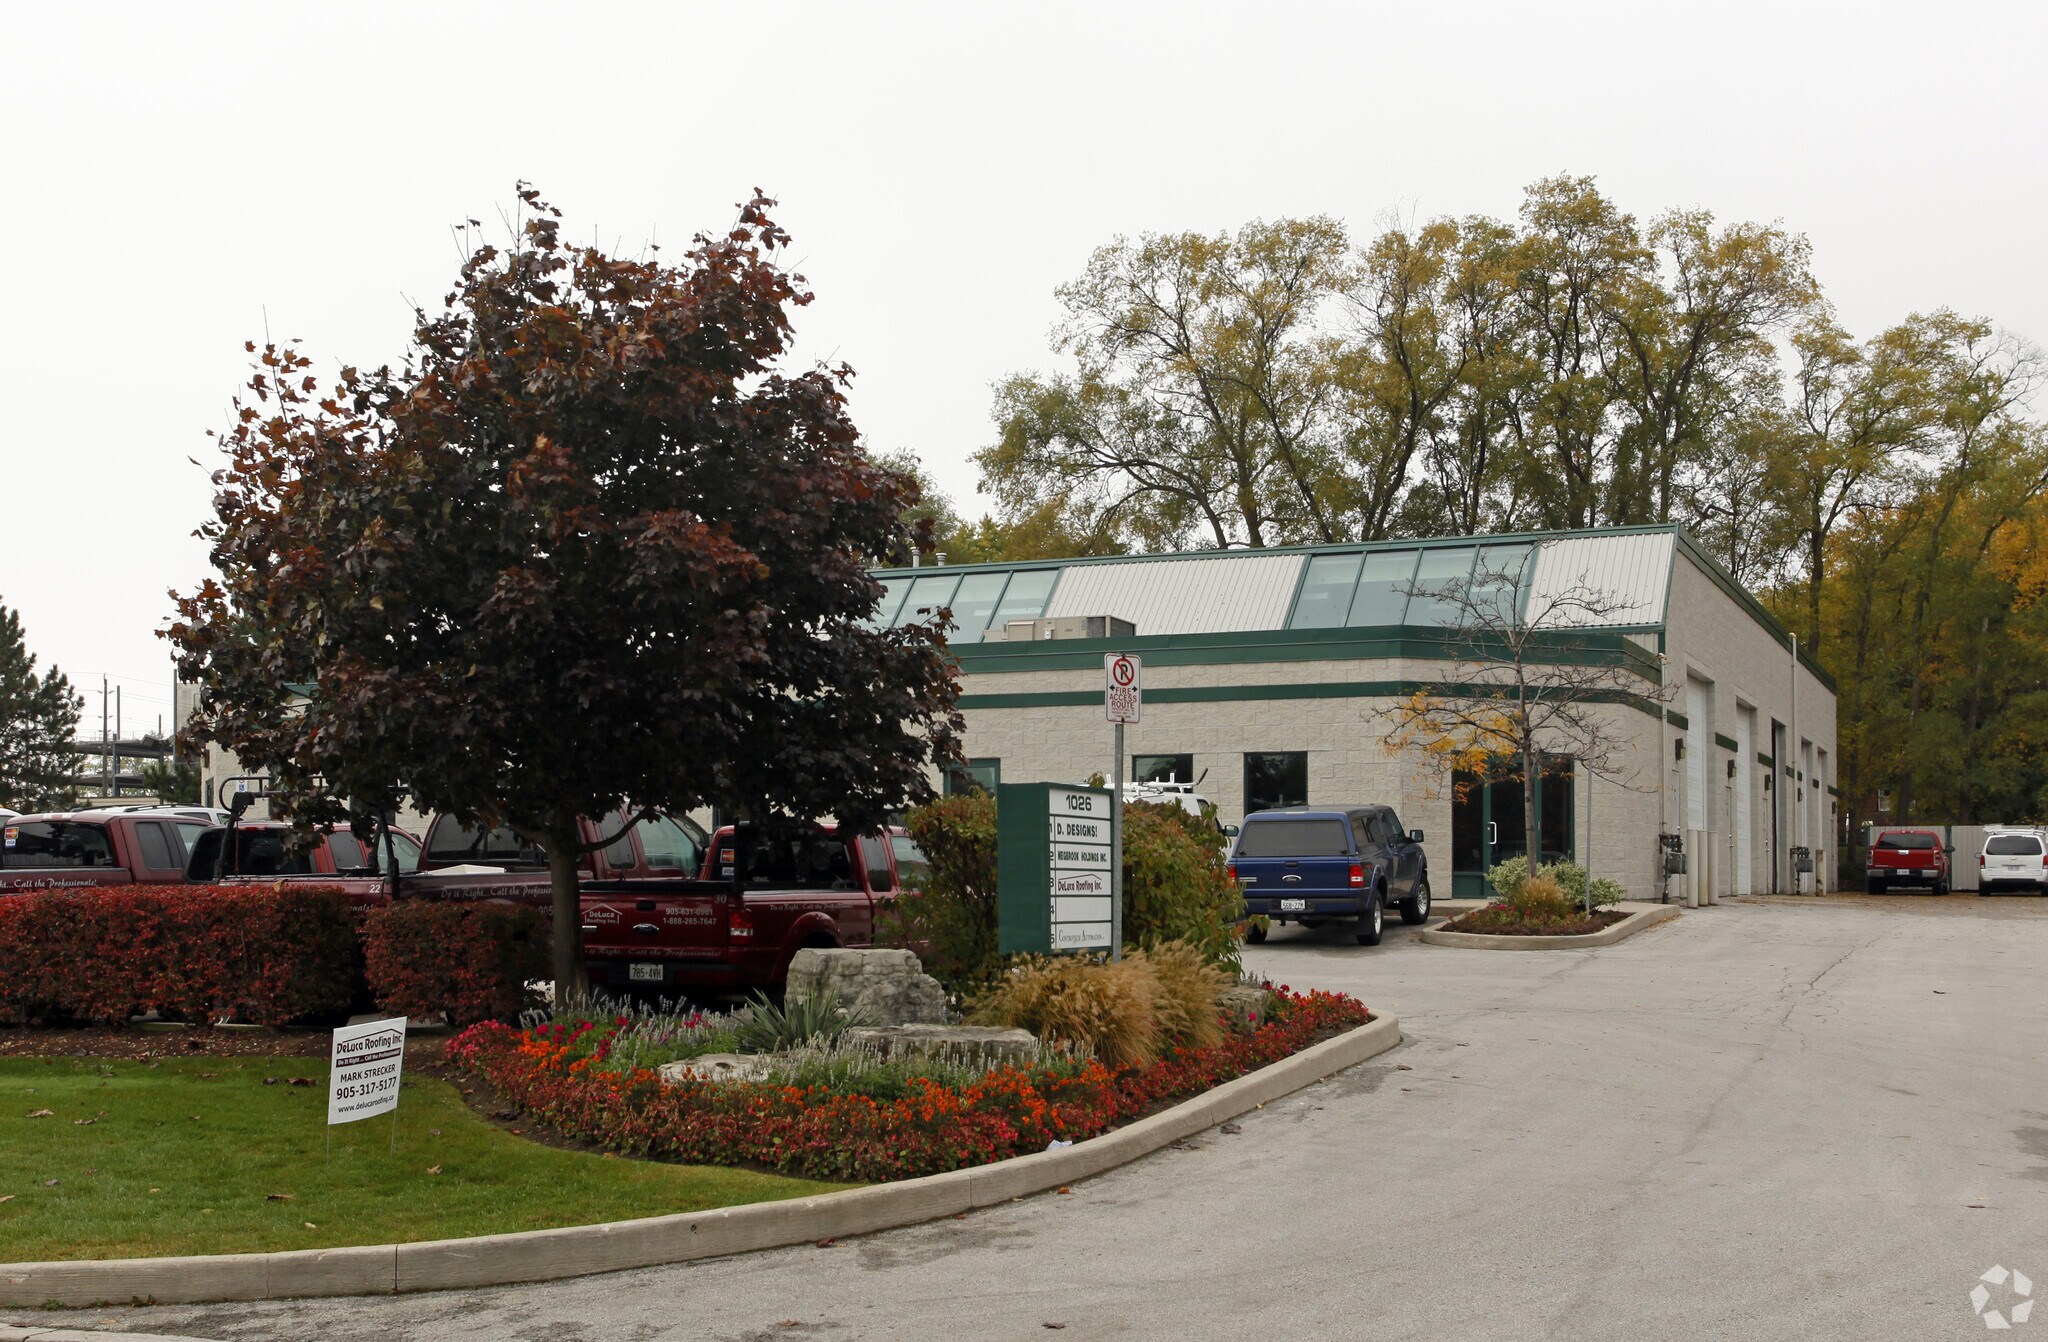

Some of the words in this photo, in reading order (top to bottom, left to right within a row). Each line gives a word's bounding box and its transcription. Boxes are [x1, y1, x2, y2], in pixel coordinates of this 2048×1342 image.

[1110, 693, 1137, 702] ACCESS
[1111, 701, 1134, 709] ROUTE
[1066, 794, 1092, 811] 1026
[1057, 823, 1064, 836] D.
[1067, 824, 1098, 838] DESIGNS!
[1081, 852, 1099, 862] HOLDINGS
[35, 879, 45, 888] the
[47, 878, 97, 889] Professionals!
[370, 884, 381, 893] 22
[1058, 881, 1075, 891] DeLuca
[1076, 880, 1093, 892] Roofing
[441, 888, 452, 898] Do
[510, 887, 519, 896] the
[714, 895, 727, 904] 30
[663, 917, 717, 925] 1-888-265-7647
[337, 1042, 363, 1054] DeLuca
[365, 1036, 391, 1050] Roofing
[393, 1034, 403, 1044] Inc.
[340, 1071, 363, 1083] MARK
[364, 1064, 396, 1079] STRECKER
[337, 1076, 397, 1100] 905-317-5177
[338, 1094, 395, 1113] www.delucaroofing.ca
